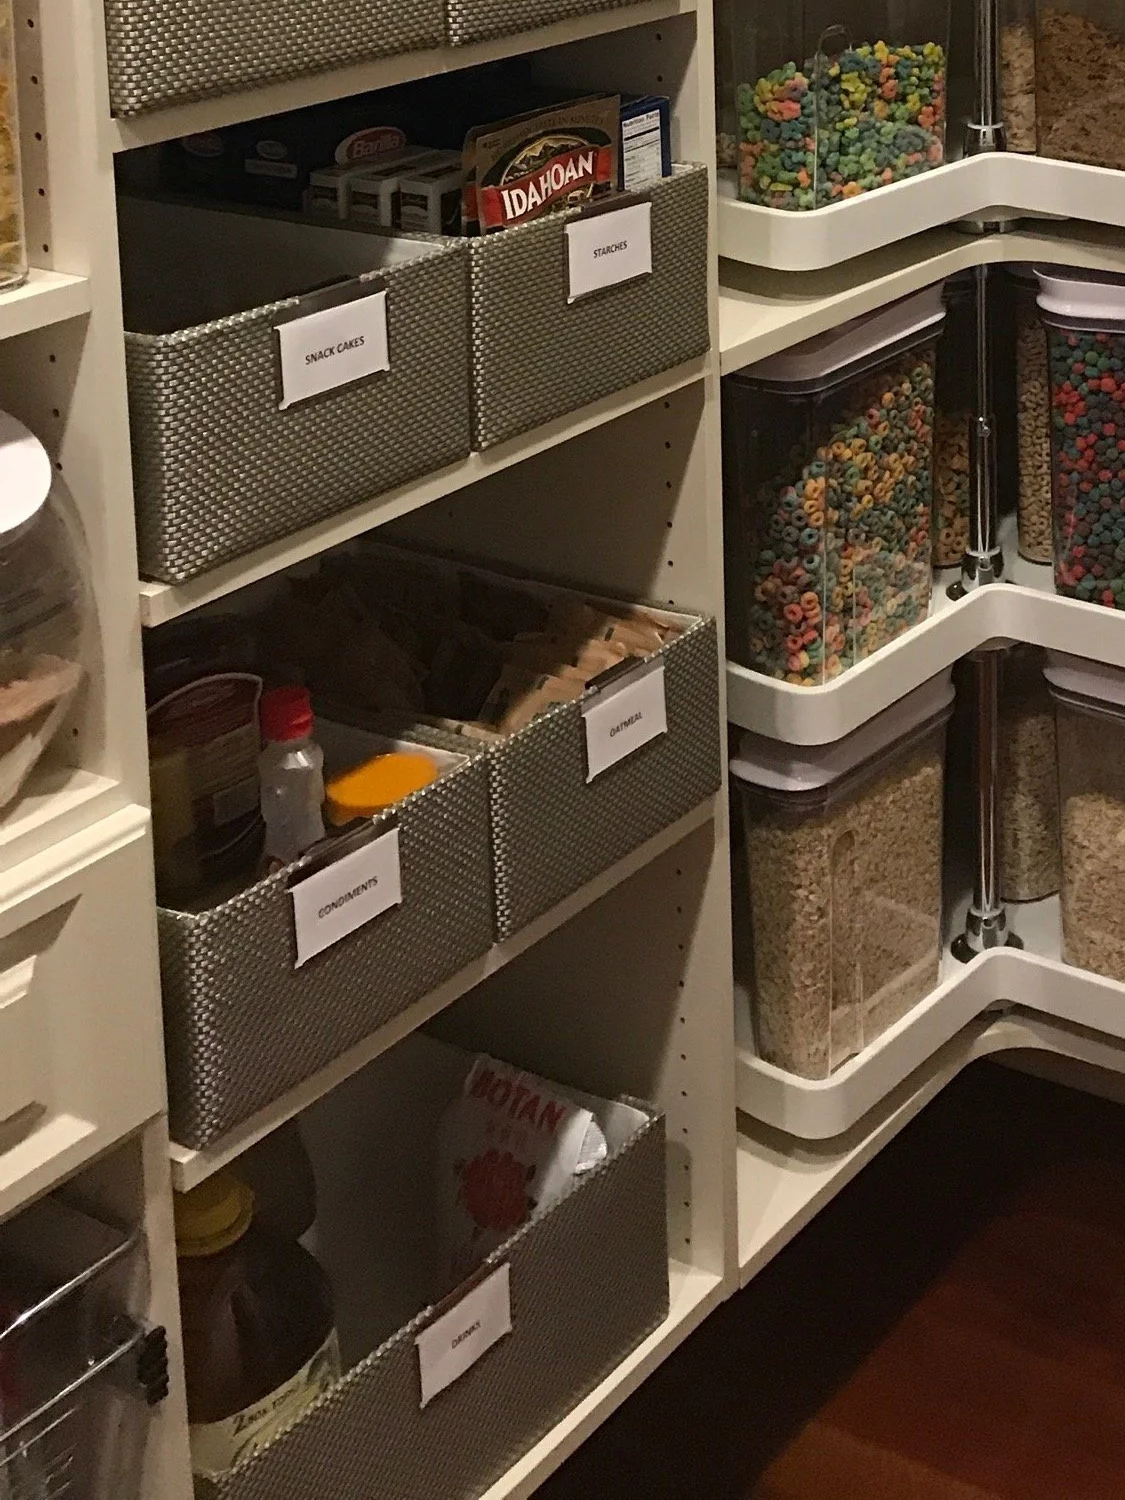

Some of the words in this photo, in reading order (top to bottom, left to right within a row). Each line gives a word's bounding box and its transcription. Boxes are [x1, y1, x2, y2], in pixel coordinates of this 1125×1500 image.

[352, 134, 400, 159] Barilla
[501, 151, 594, 220] IDAHOAN
[593, 240, 628, 259] STARCHES
[305, 346, 335, 366] SNACK
[336, 335, 365, 354] CAKES
[609, 711, 643, 738] OATMEAL
[318, 875, 379, 919] CONDIMENTS
[470, 1067, 567, 1133] BOTAN
